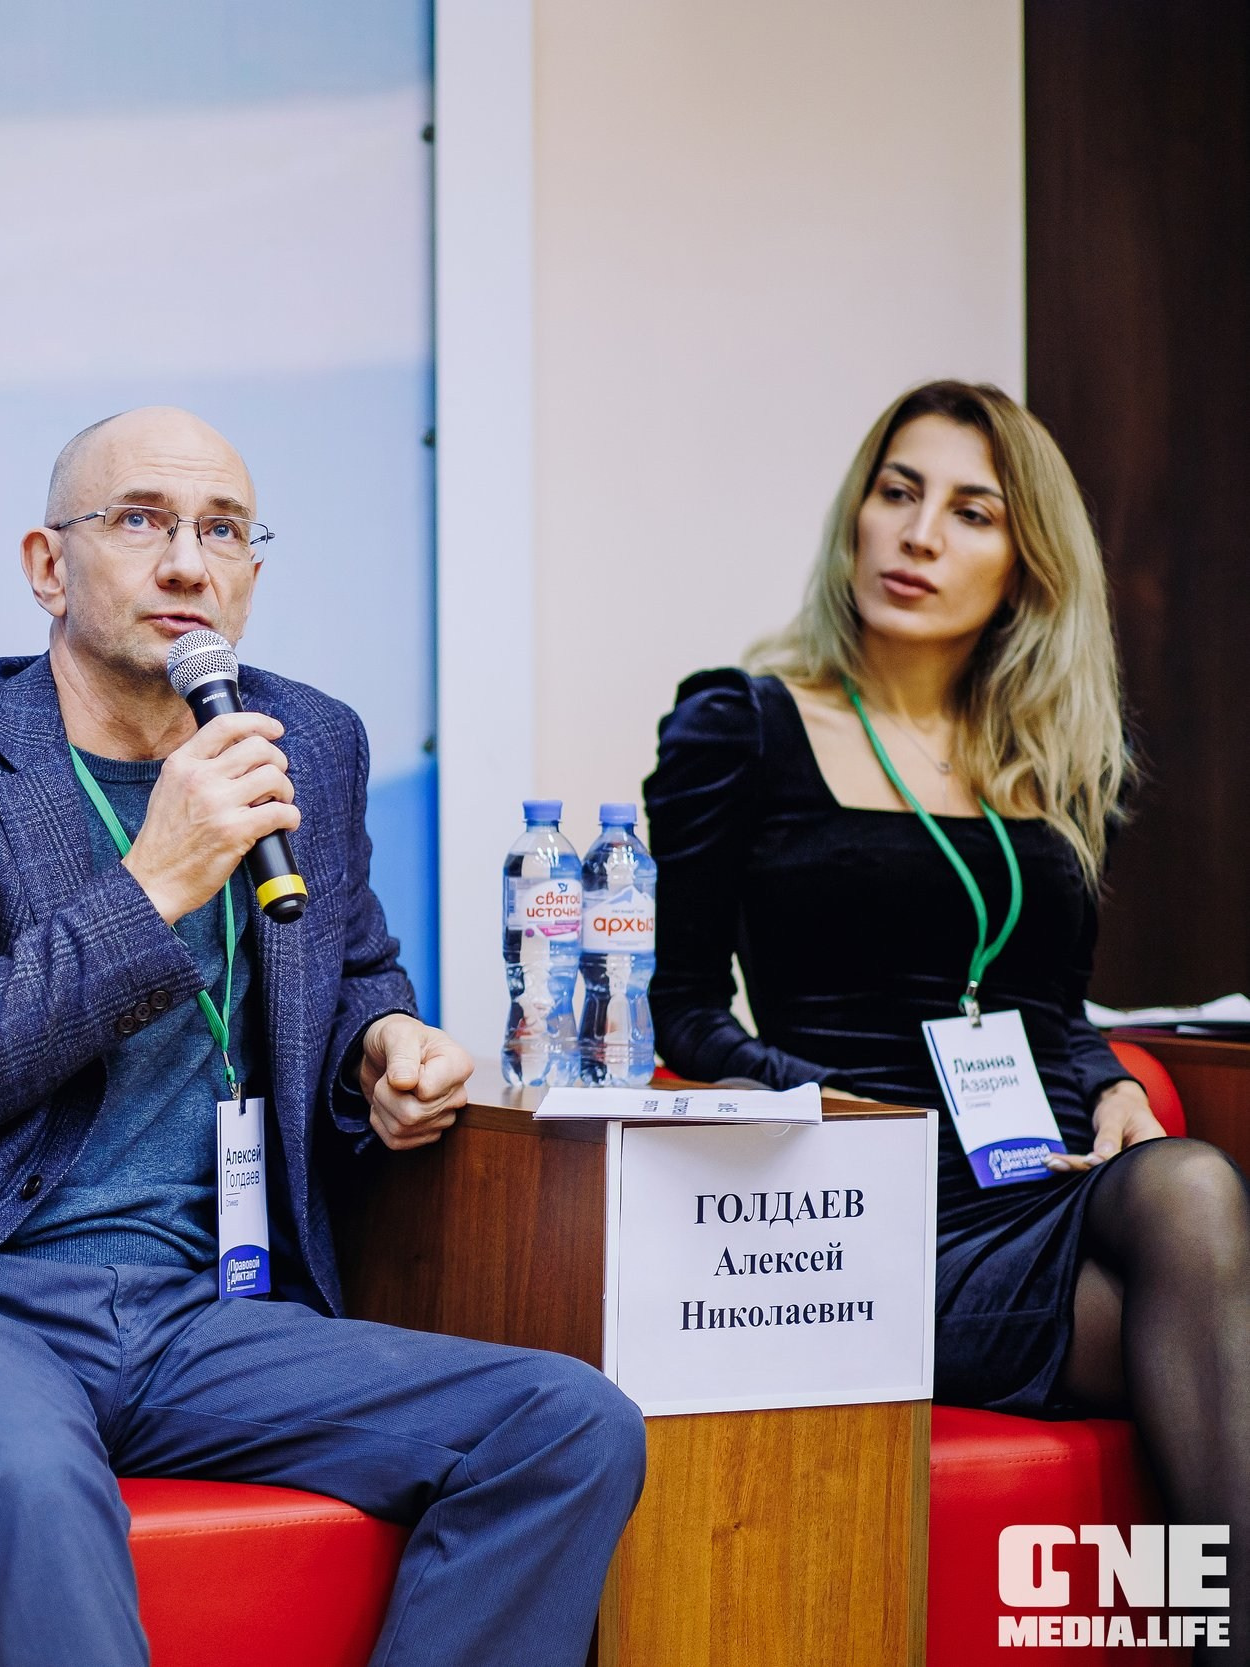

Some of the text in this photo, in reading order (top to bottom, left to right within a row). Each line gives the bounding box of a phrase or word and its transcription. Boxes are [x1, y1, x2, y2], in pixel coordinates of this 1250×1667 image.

[953, 1054, 1016, 1074] Лианна
[960, 1074, 1020, 1095] Азарян
[225, 1144, 262, 1166] Алексей
[225, 1170, 260, 1190] Голдаев
[694, 1188, 865, 1229] ГОЛДАЕВ
[230, 1255, 260, 1272] Правовой
[713, 1241, 844, 1276] Алексей
[679, 1300, 874, 1331] Николаевич
